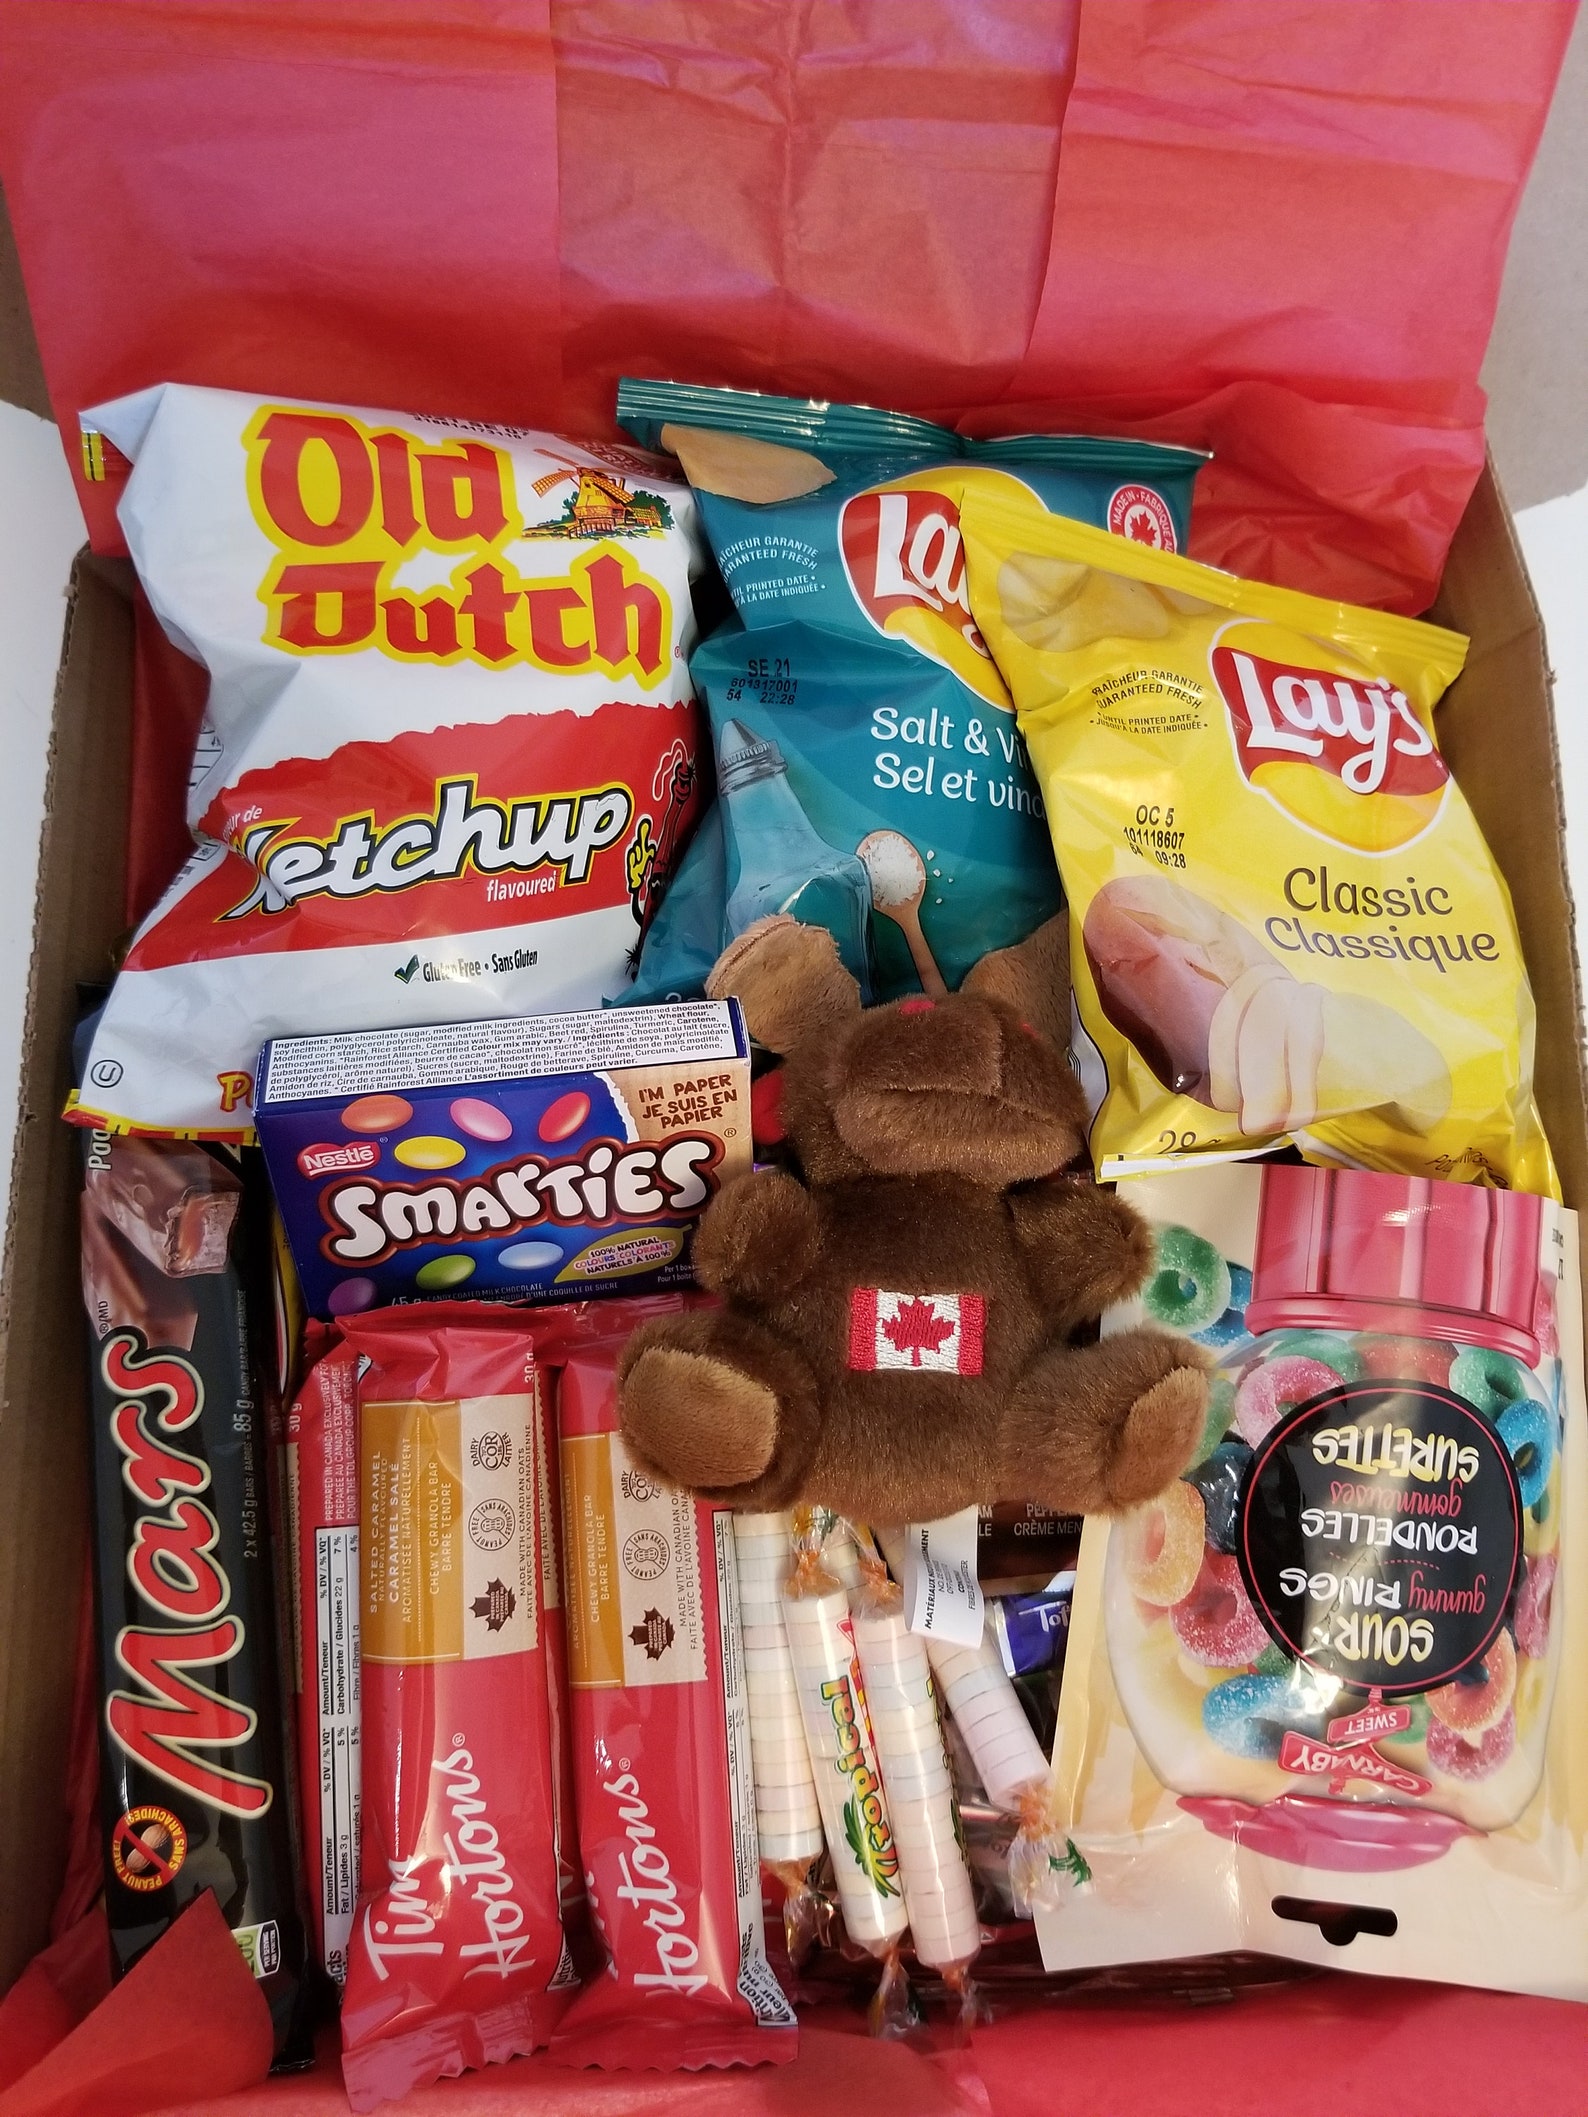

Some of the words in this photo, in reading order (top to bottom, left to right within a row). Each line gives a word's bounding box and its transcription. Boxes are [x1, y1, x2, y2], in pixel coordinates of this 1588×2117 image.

[257, 412, 508, 547] Old
[1113, 494, 1128, 526] MADE
[764, 535, 819, 558] GARANTIE
[782, 549, 818, 570] FRESH
[746, 579, 784, 592] PRINTED
[787, 574, 809, 586] DATE
[747, 594, 757, 603] LA
[760, 590, 779, 600] DATE
[781, 583, 819, 597] INDIQUÉE
[273, 553, 662, 676] Dutch
[748, 659, 769, 677] SE
[775, 658, 790, 677] 21
[1151, 670, 1204, 694] GARANTIE
[1167, 686, 1202, 709] FRESH
[871, 707, 954, 749] Salt
[964, 718, 990, 756] &
[1129, 716, 1166, 726] PRINTED
[1169, 714, 1192, 723] DATE
[1141, 726, 1161, 735] DATE
[1164, 721, 1202, 733] INDIQUÉE
[1231, 652, 1433, 793] Lay's
[873, 753, 935, 795] Sel
[942, 770, 978, 801] et
[243, 805, 262, 822] de
[1136, 805, 1160, 825] OC
[1165, 808, 1174, 827] 5
[216, 774, 632, 920] Ketchup
[1155, 850, 1186, 868] 09:28
[487, 871, 557, 902] flavoured
[1284, 865, 1453, 917] Classic
[492, 953, 513, 973] Sans
[514, 949, 537, 969] Gluten
[1265, 917, 1500, 974] Classique
[274, 1037, 331, 1049] Ingredients:
[355, 1032, 398, 1041] chocolate
[400, 1029, 430, 1038] (sugar,
[433, 1025, 471, 1034] modified
[494, 1018, 546, 1029] ingredients,
[611, 1007, 669, 1017] unsweetened
[638, 1086, 664, 1102] I'M
[673, 1074, 732, 1096] PAPER
[642, 1104, 663, 1119] JE
[668, 1096, 707, 1113] SUIS
[712, 1089, 737, 1105] EN
[660, 1106, 723, 1129] PAPIER
[575, 1255, 615, 1269] COLOURS
[586, 1259, 633, 1274] NATURELS
[644, 1250, 672, 1261] 100%
[590, 1247, 615, 1258] 100%
[617, 1237, 660, 1252] NATURAL
[233, 1413, 251, 1432] 85
[323, 1430, 332, 1464] CANADA
[334, 1428, 343, 1461] CANADA
[471, 1437, 480, 1467] DAIRY
[484, 1434, 499, 1469] COR
[524, 1424, 532, 1490] CANADIENNE
[1313, 1423, 1479, 1482] SURETTES
[346, 1477, 355, 1494] THE
[389, 1463, 399, 1505] SALÉ
[402, 1438, 411, 1537] NATURELLEMENT
[428, 1462, 438, 1485] BAR
[621, 1471, 630, 1498] DAIRY
[325, 1478, 333, 1520] PREPARED
[371, 1451, 380, 1539] CARAMEL
[441, 1482, 451, 1528] TENDRE
[584, 1494, 594, 1516] BAR
[1330, 1478, 1462, 1516] gommeuses
[429, 1489, 439, 1547] GRANOLA
[1014, 1519, 1054, 1536] CRÈME
[1301, 1509, 1477, 1554] RONDELLES
[334, 1536, 341, 1545] %
[442, 1532, 452, 1571] BARRE
[518, 1536, 526, 1562] WITH
[586, 1519, 597, 1576] GRANOLA
[596, 1513, 606, 1559] TENDRE
[673, 1509, 683, 1562] CANADIAN
[683, 1526, 692, 1570] L'AVOINE
[389, 1511, 399, 1602] CARAMEL
[429, 1551, 440, 1595] CHEWY
[106, 1333, 273, 1820] Mars
[320, 1572, 327, 1587] DV
[335, 1586, 342, 1598] 22
[370, 1546, 378, 1613] SALTED
[600, 1563, 610, 1600] BARRE
[676, 1567, 685, 1592] WITH
[686, 1574, 694, 1588] DE
[1279, 1567, 1401, 1609] RINGS
[589, 1580, 600, 1623] CHEWY
[678, 1596, 687, 1626] MADE
[688, 1592, 696, 1616] AVEC
[924, 1578, 936, 1630] MATÉRIAUX
[1410, 1574, 1485, 1616] gummy
[335, 1602, 343, 1640] Glucides
[689, 1621, 698, 1650] FAITE
[1334, 1613, 1434, 1665] SOUR
[337, 1650, 345, 1715] Carbohydrate
[338, 1727, 345, 1737] %
[1344, 1711, 1397, 1734] SWEET
[324, 1767, 331, 1780] DV
[820, 1676, 898, 1878] Tropical
[1291, 1749, 1420, 1792] CARNABY
[169, 1838, 185, 1871] SANS
[365, 1855, 443, 1981] Tim
[433, 1748, 535, 1979] Hortons
[123, 1874, 162, 1891] PEANUT
[326, 1837, 334, 1914] Amount/Teneur
[341, 1852, 350, 1891] Lipides
[341, 1899, 349, 1914] Fat
